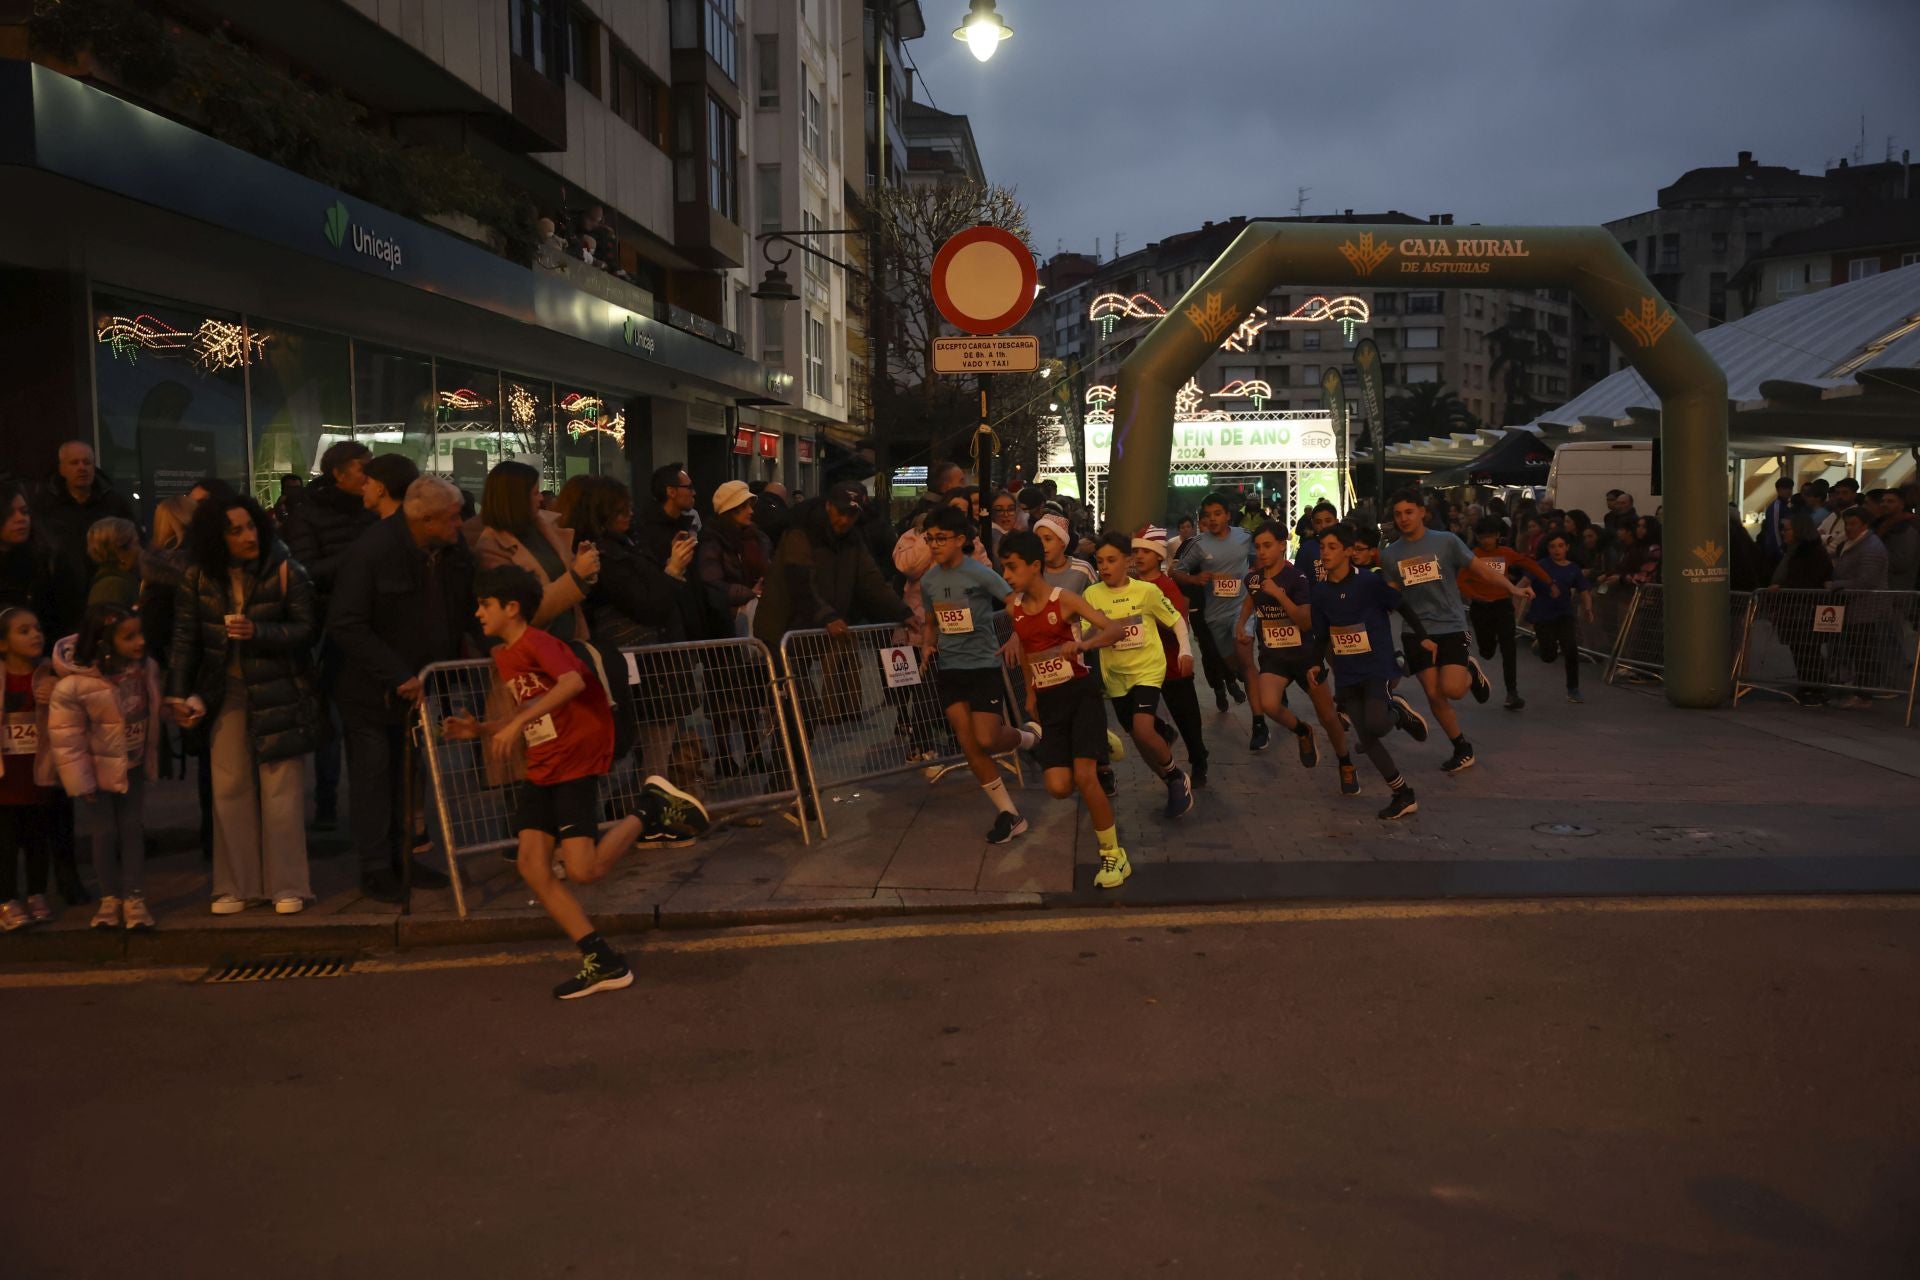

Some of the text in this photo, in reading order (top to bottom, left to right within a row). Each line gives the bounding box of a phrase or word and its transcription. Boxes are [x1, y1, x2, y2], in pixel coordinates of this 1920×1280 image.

[352, 223, 402, 271] Unicaja
[1400, 239, 1530, 258] CAJA RURAL
[1401, 262, 1490, 273] DE ASTURIAS
[1184, 428, 1213, 447] FIN
[1220, 428, 1244, 446] DE
[1177, 448, 1206, 459] 2024
[1407, 563, 1432, 576] 1586
[1488, 562, 1502, 570] 595
[1681, 568, 1705, 577] CAJA
[1217, 580, 1237, 589] 1601
[940, 610, 964, 622] 1583
[1267, 626, 1294, 638] 1600
[1336, 634, 1362, 644] 1590
[1034, 658, 1062, 674] 1566
